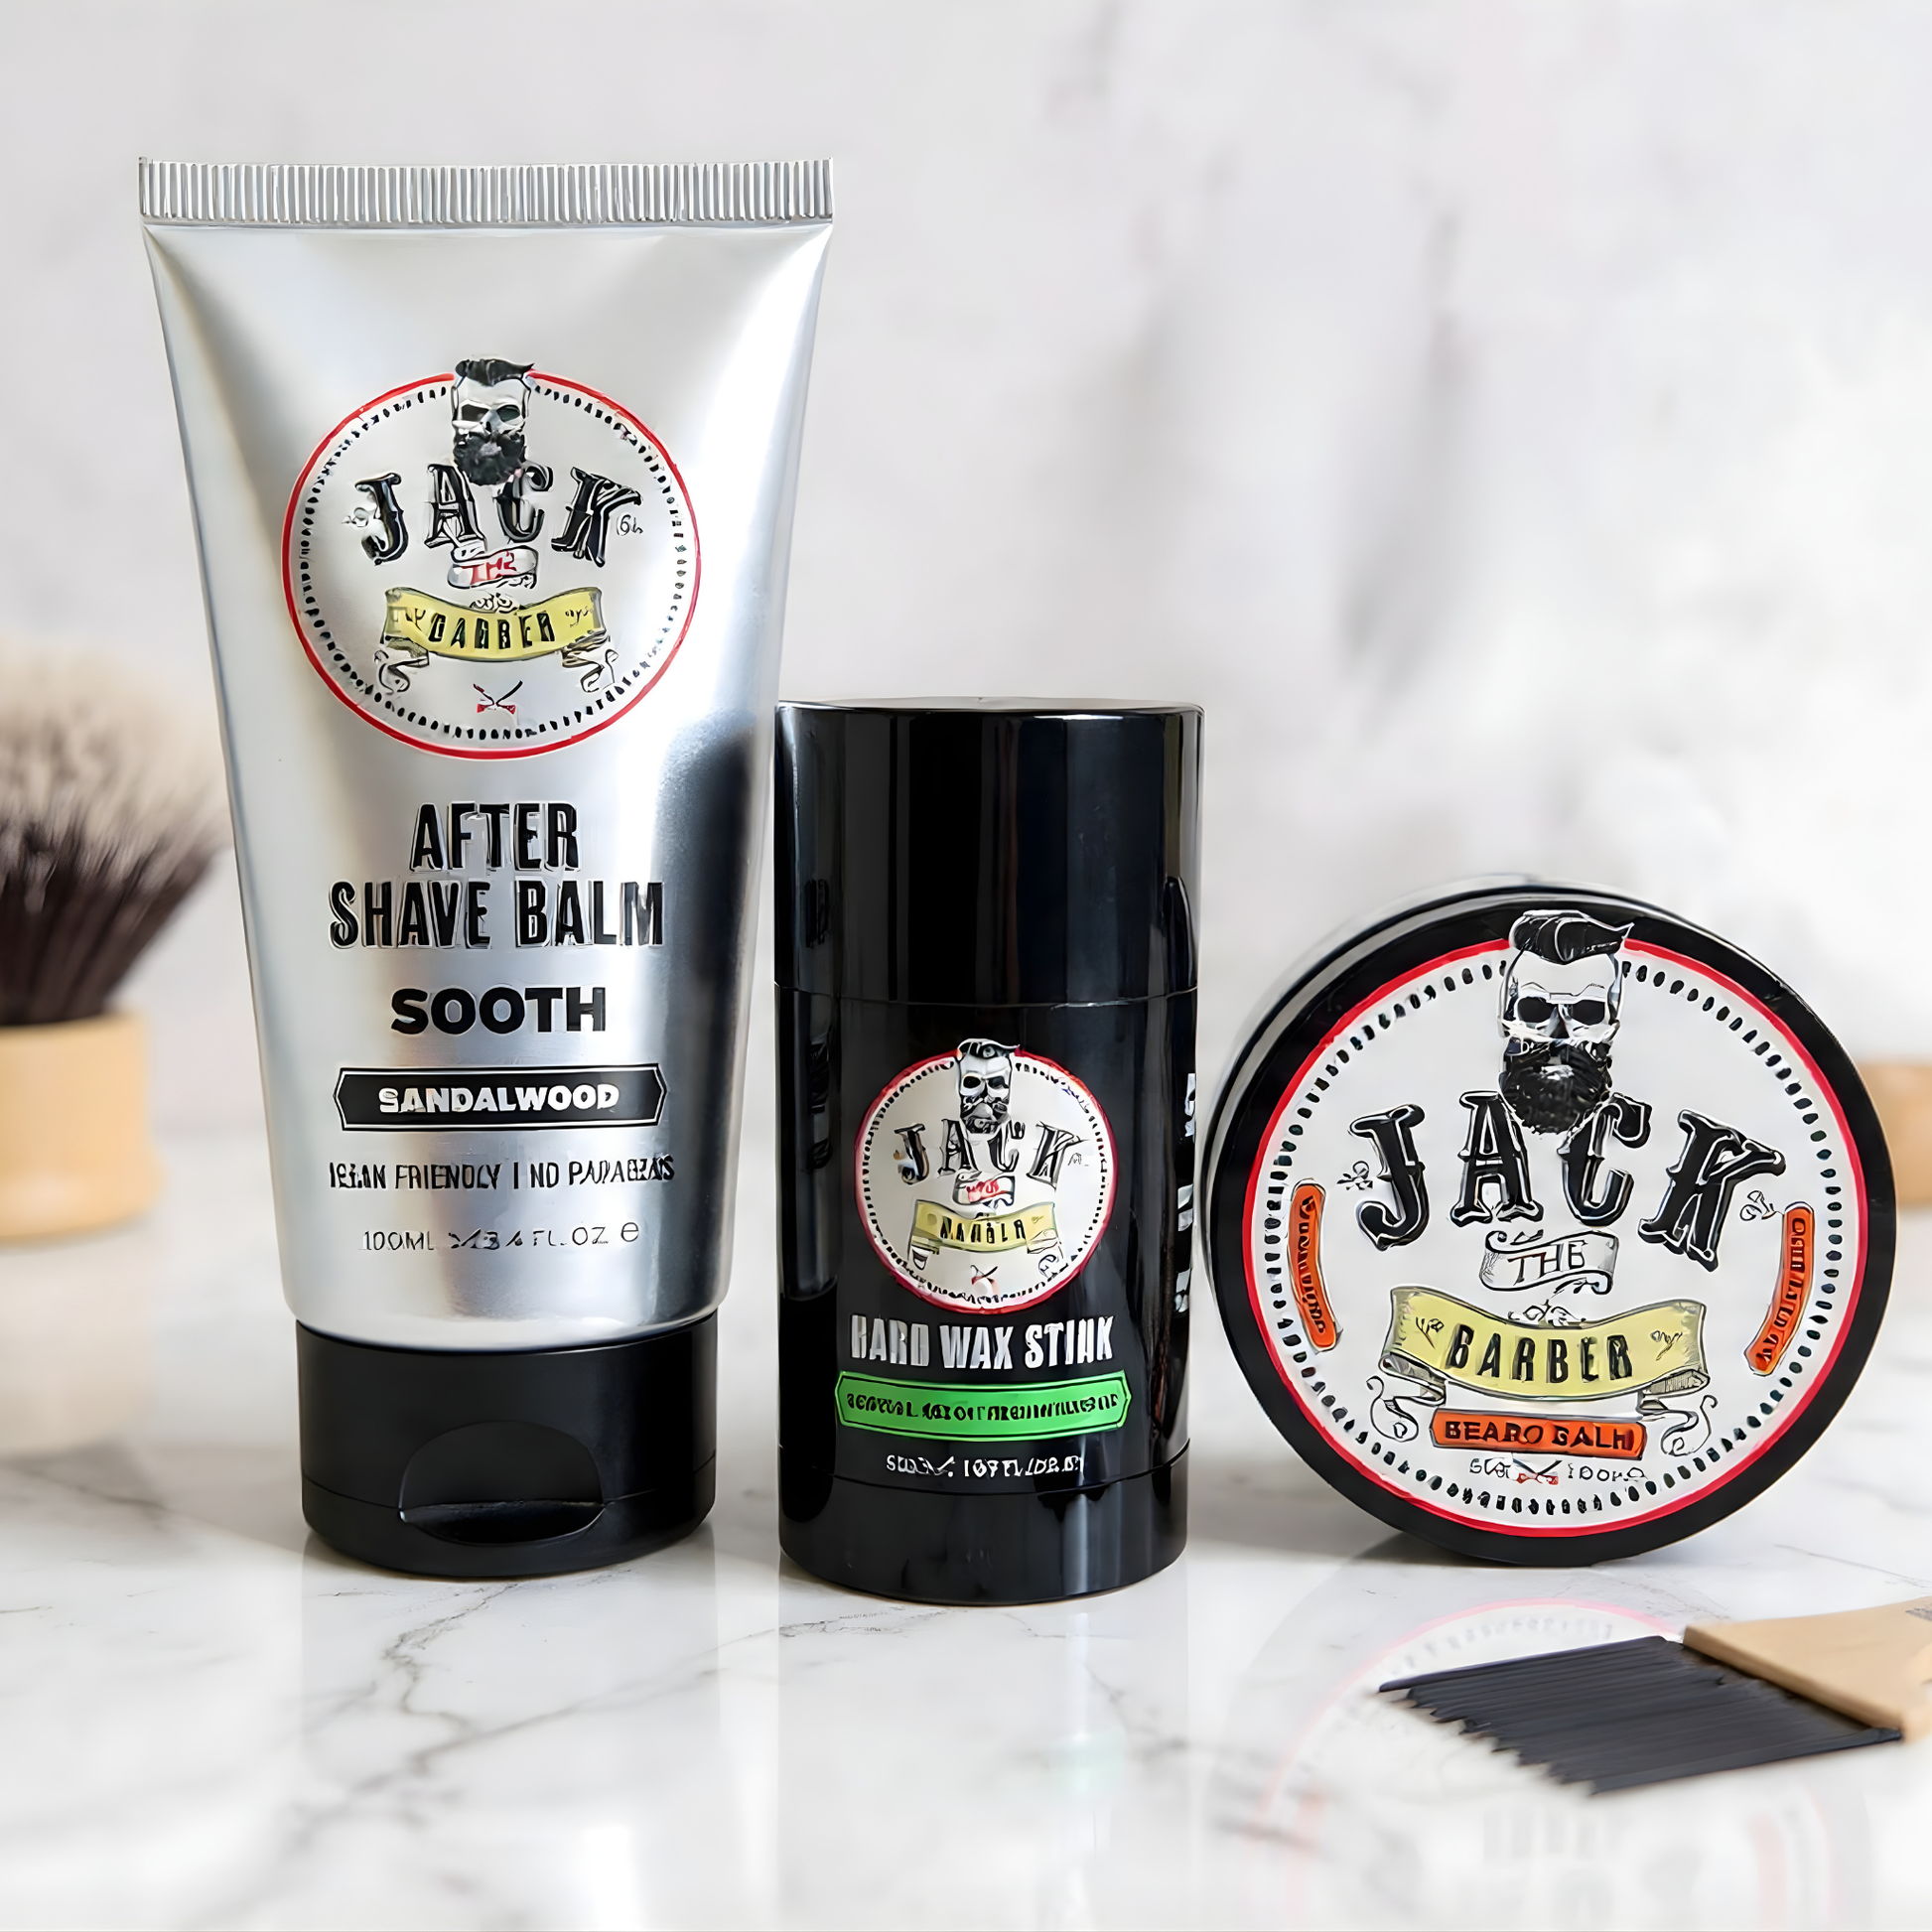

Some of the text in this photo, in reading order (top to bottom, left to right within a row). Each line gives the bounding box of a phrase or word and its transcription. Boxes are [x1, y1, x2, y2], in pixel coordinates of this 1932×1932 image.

[354, 463, 643, 567] JACK
[408, 801, 579, 873] AFTER
[329, 879, 664, 949] SHAVE BALM
[390, 986, 607, 1035] SOOTH
[378, 1083, 621, 1114] SANDALWOOD
[1350, 1089, 1786, 1272] JACK
[939, 1323, 1015, 1370] WAX
[1446, 1323, 1633, 1385] BARBER
